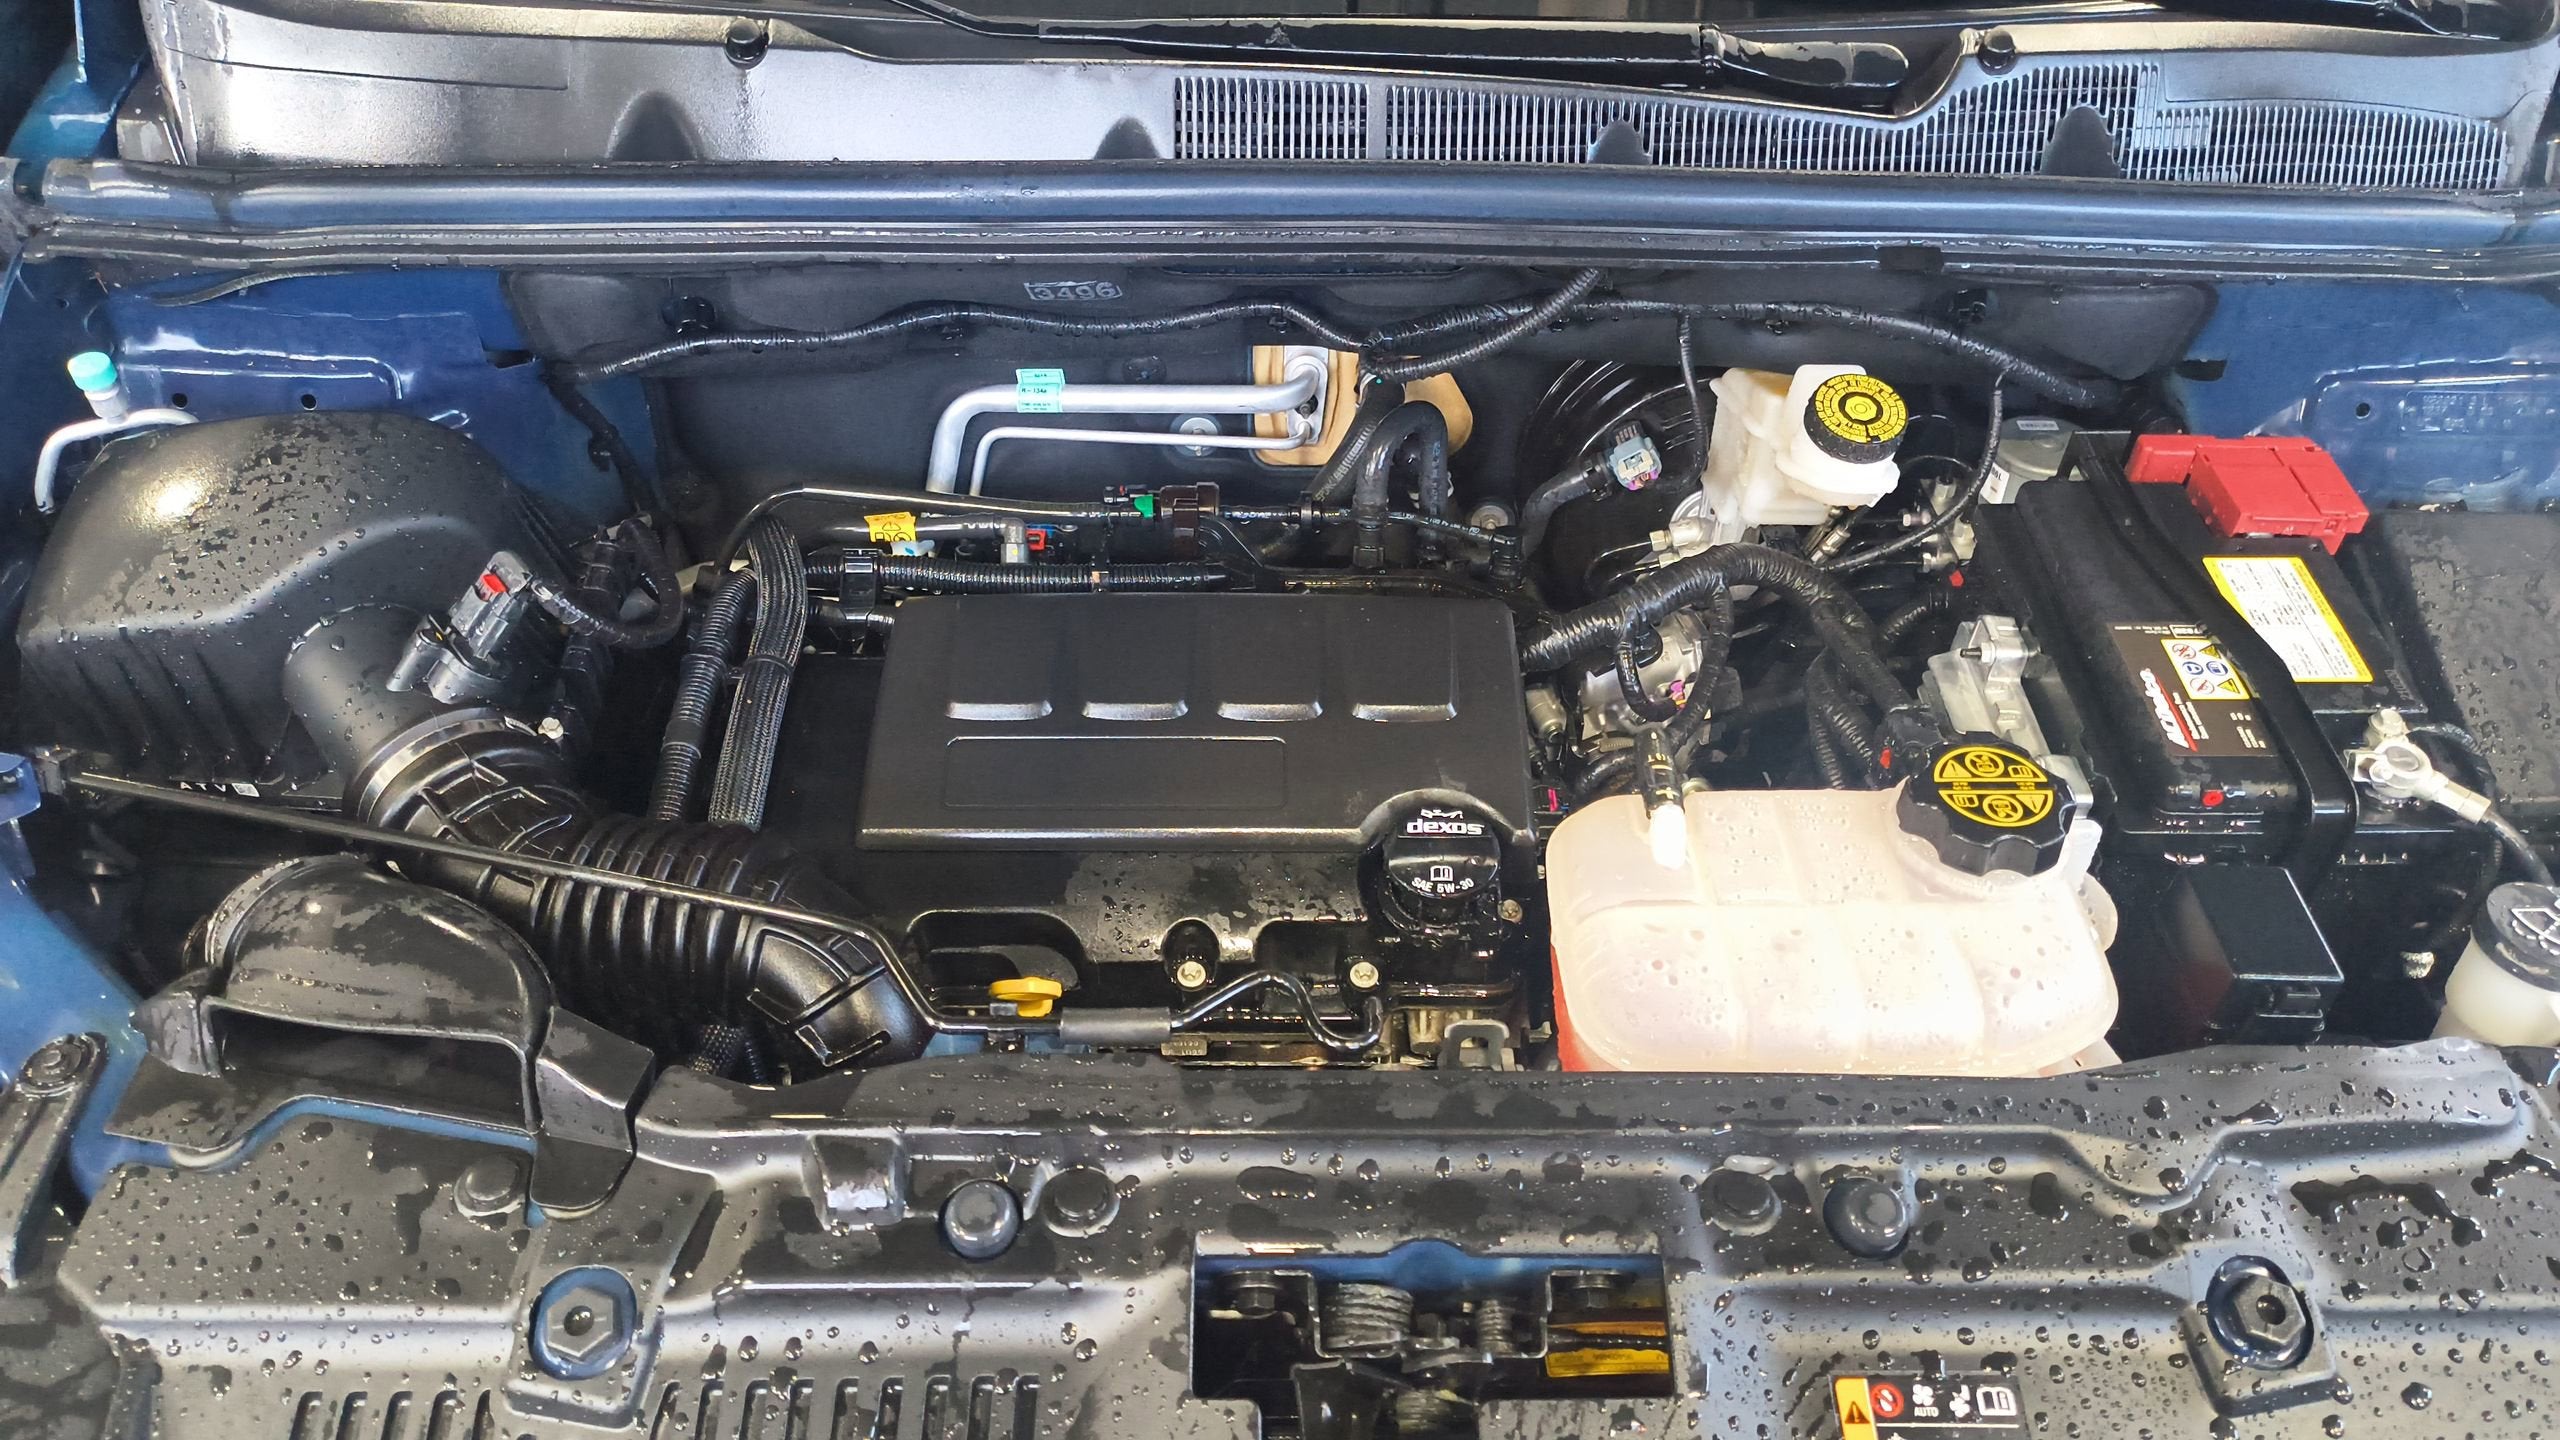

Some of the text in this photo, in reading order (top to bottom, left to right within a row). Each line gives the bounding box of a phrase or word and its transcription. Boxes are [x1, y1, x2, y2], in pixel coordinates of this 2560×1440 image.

[1033, 281, 1116, 300] 3496
[1406, 818, 1485, 835] dexos
[1411, 877, 1474, 893] SAE 5W-30
[1914, 1406, 1939, 1417] AUTO
